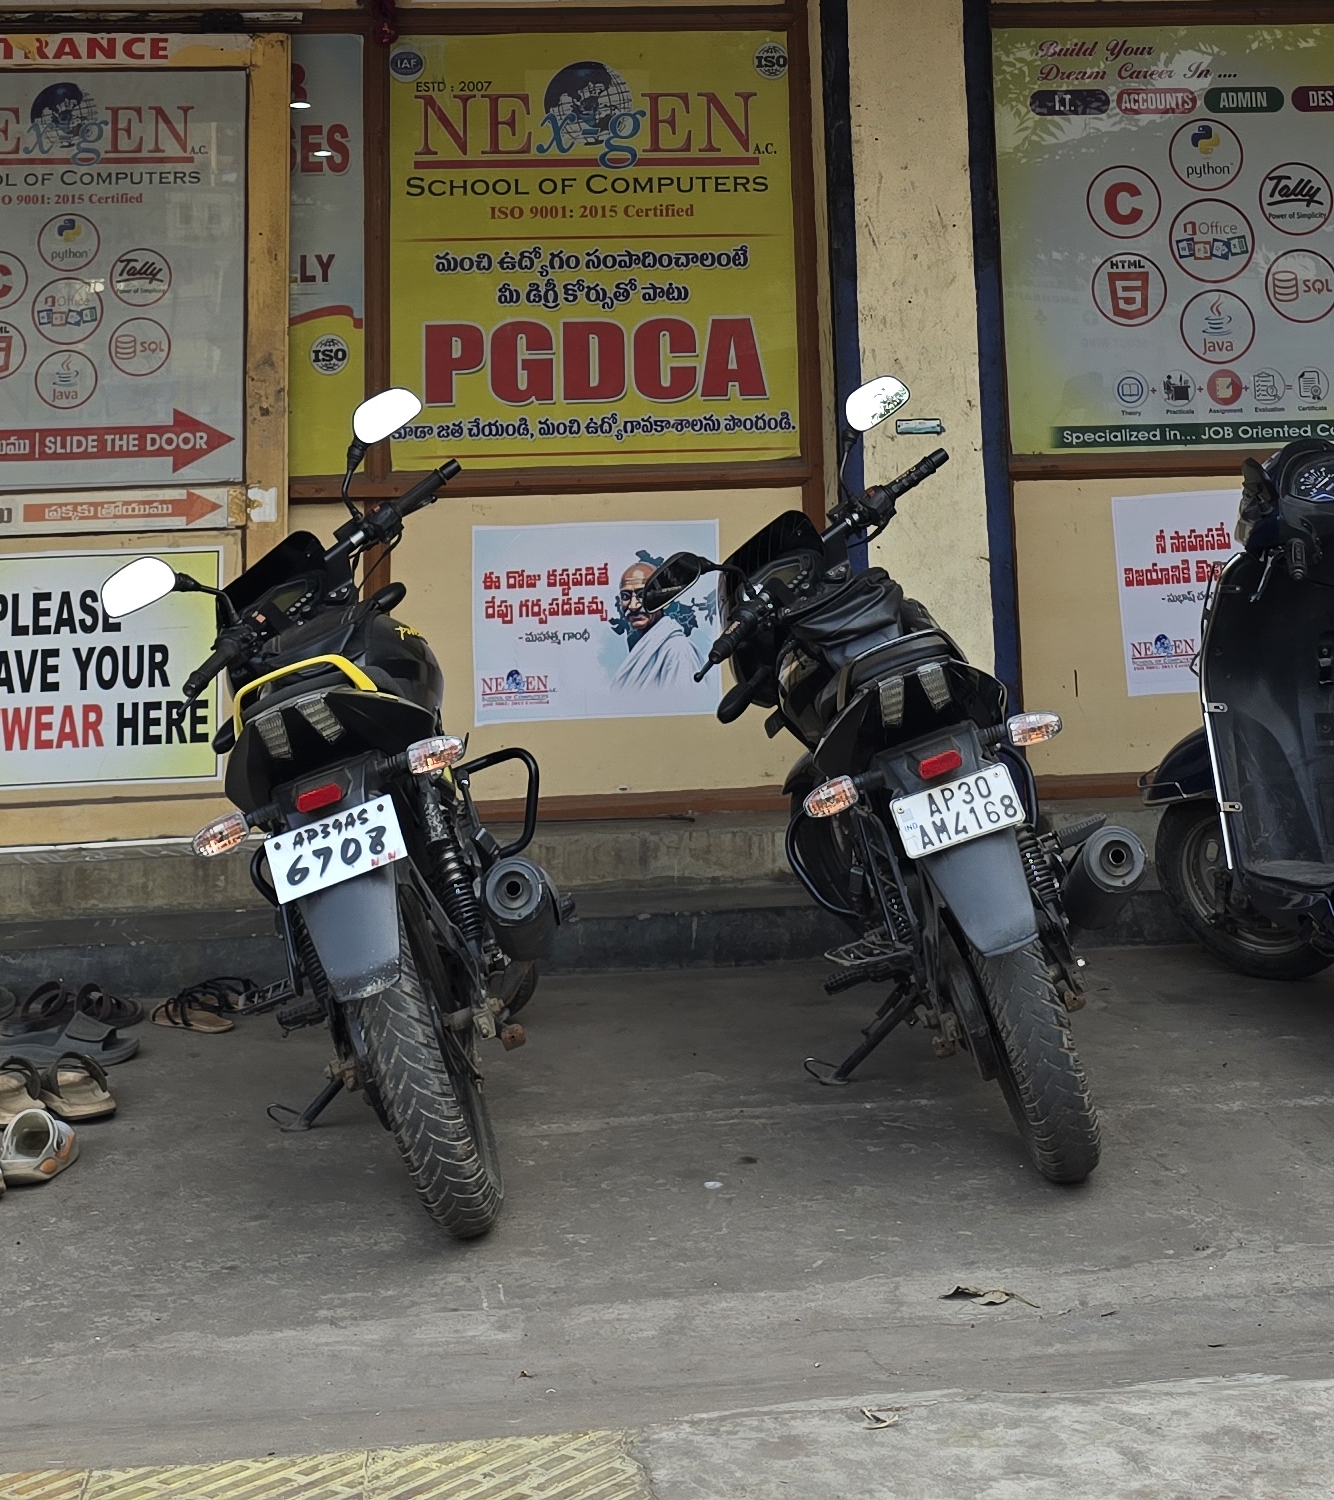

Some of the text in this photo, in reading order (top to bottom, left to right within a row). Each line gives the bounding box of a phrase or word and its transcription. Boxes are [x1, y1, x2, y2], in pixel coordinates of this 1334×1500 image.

[434, 244, 749, 277] మంచి ఉద్యోగం సంపాదించాలంటే
[1110, 259, 1145, 269] HTML
[1303, 279, 1332, 294] SQL
[425, 316, 769, 406] PGDCA
[45, 432, 207, 453] SLIDE THE DOOR
[1063, 422, 1311, 444] Specialized in... JOB Oriented
[73, 644, 171, 691] YOUR
[117, 700, 210, 747] HERE
[928, 776, 991, 818] AP30
[293, 808, 368, 849] AP39AS
[919, 795, 1017, 850] AM4168
[287, 825, 386, 886] 6708
